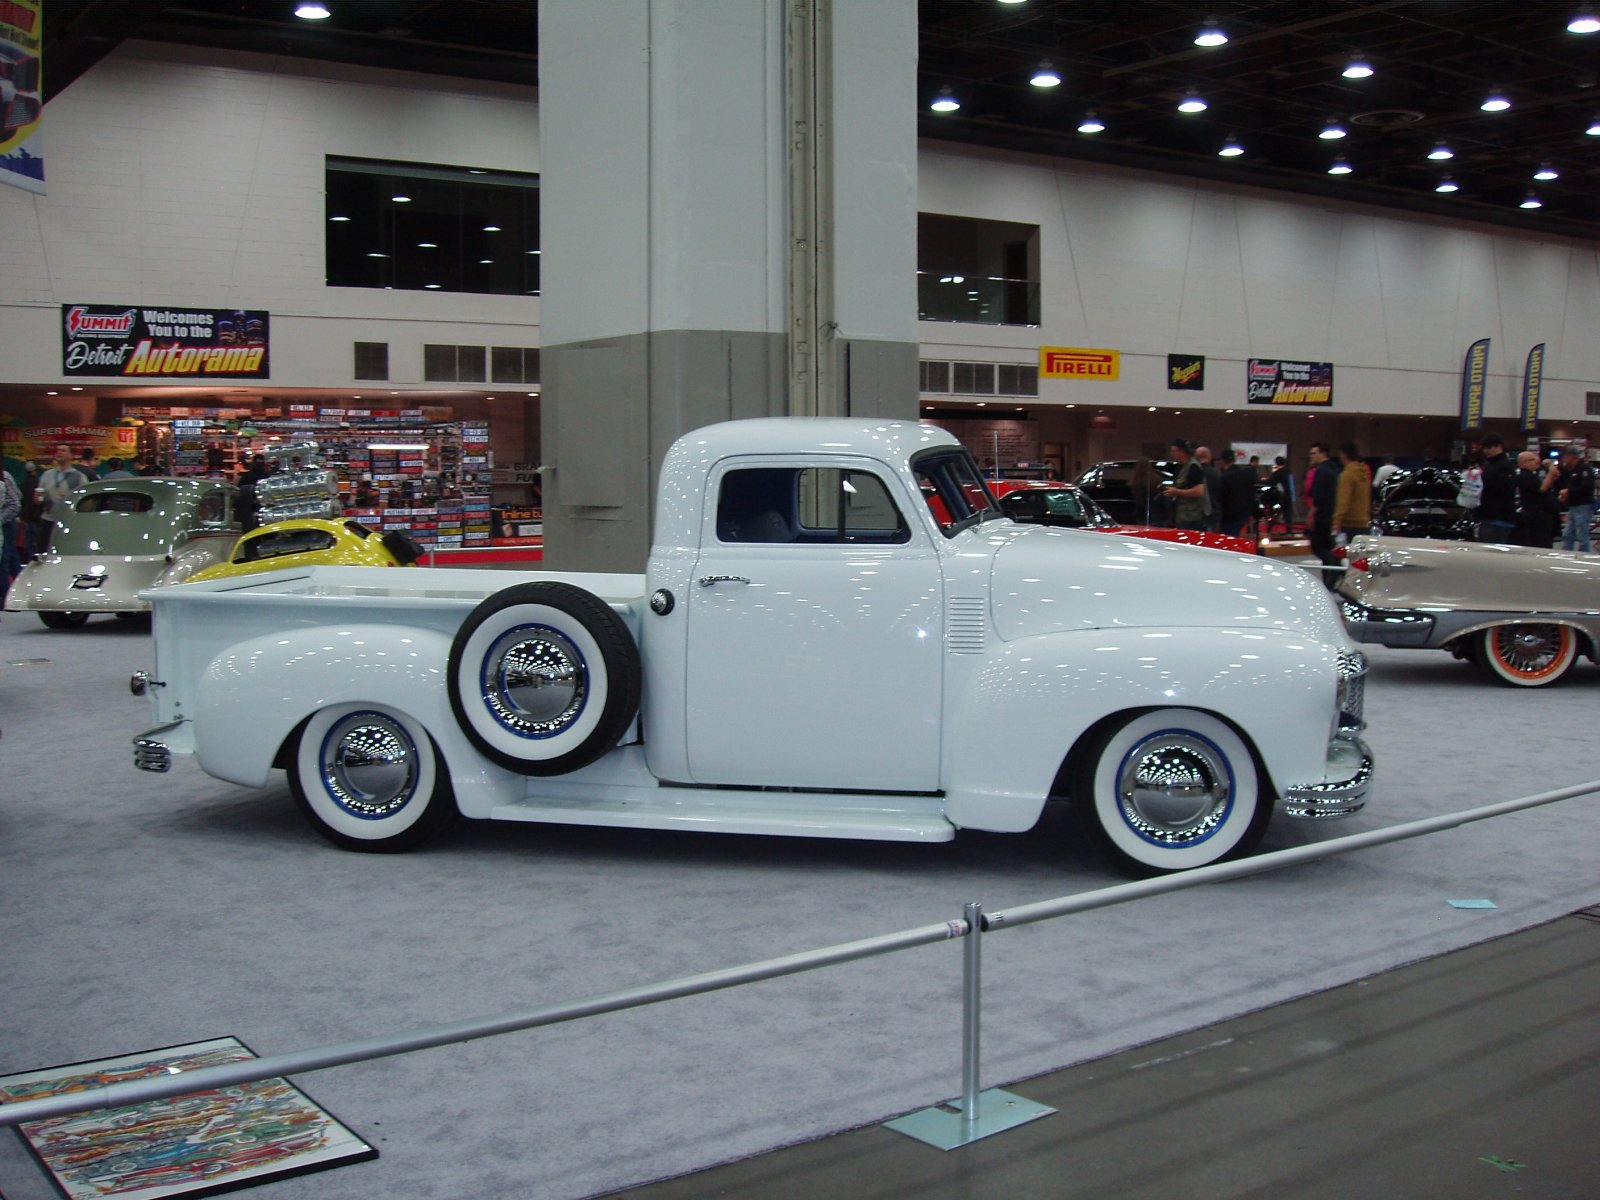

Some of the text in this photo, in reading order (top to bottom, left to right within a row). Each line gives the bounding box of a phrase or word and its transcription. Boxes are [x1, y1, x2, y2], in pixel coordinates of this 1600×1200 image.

[143, 310, 214, 325] Welcomes
[148, 324, 213, 338] You to the
[66, 340, 265, 374] Detroit Autorama
[1047, 351, 1112, 376] PIRELLI
[1272, 381, 1331, 403] Autorama
[24, 425, 113, 439] SUPER SHAMMY
